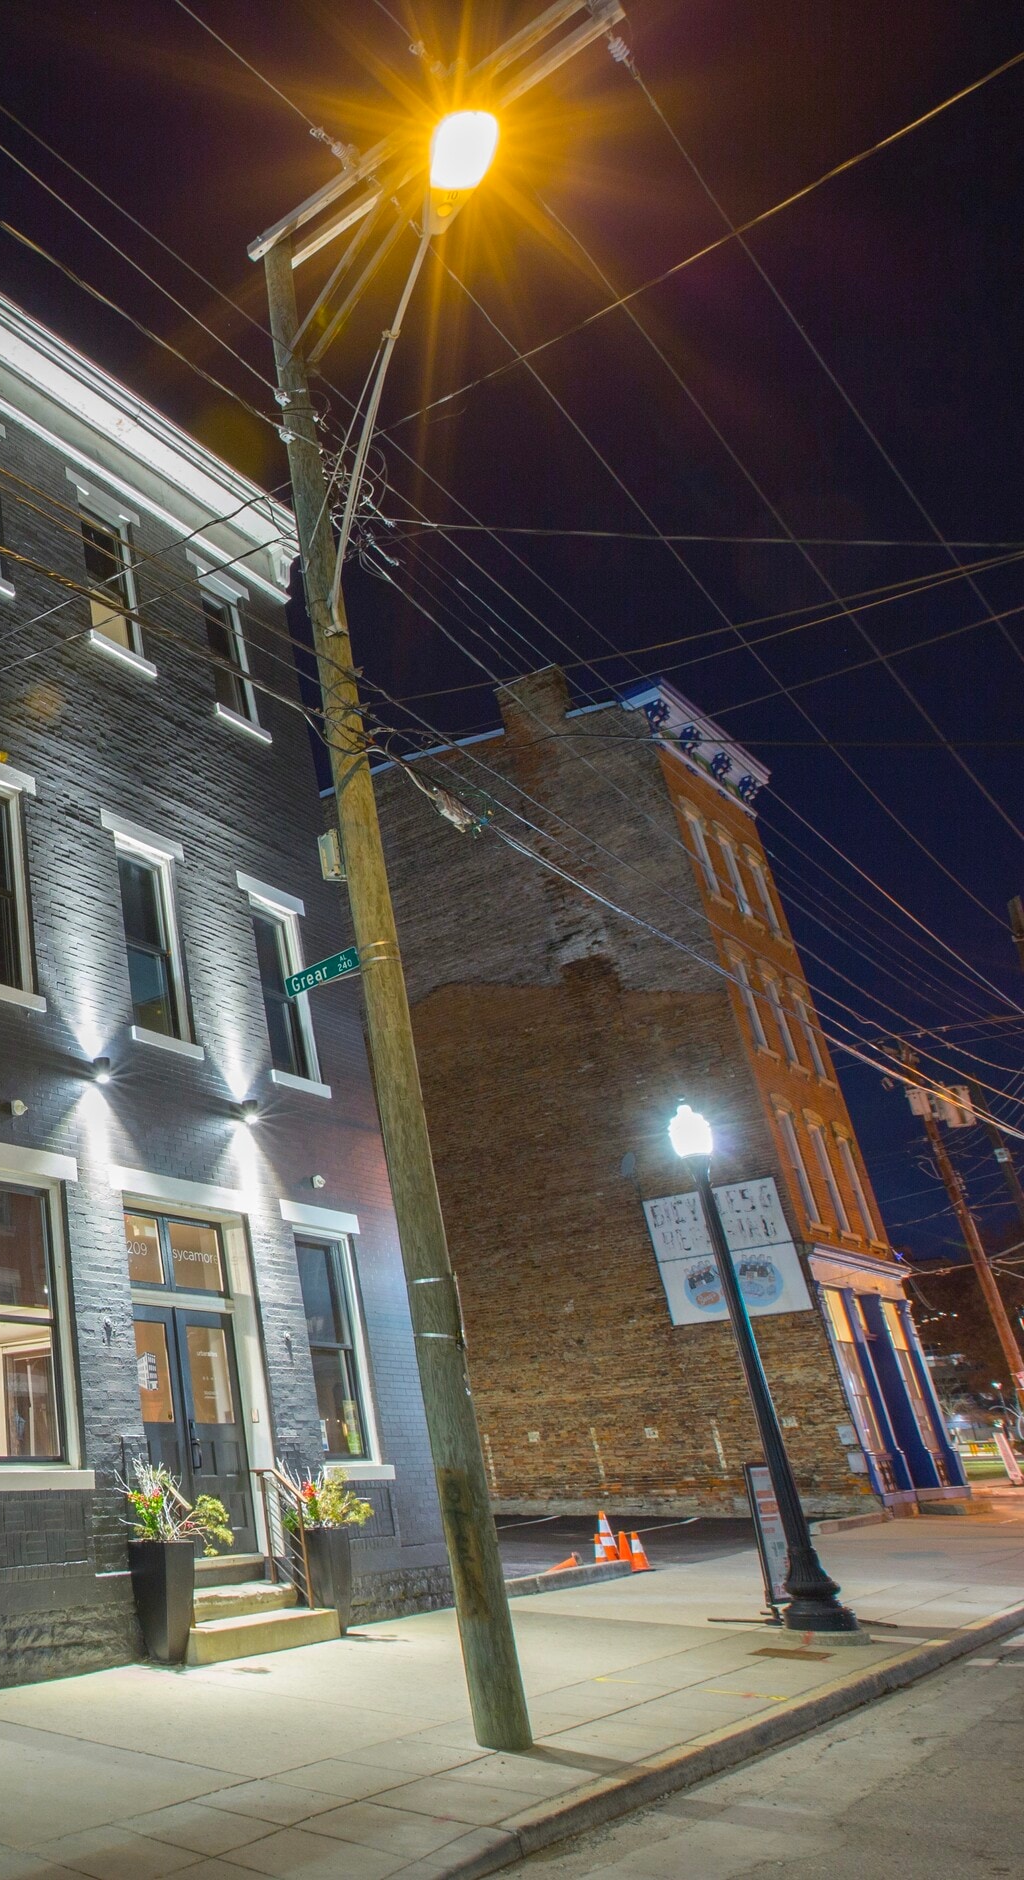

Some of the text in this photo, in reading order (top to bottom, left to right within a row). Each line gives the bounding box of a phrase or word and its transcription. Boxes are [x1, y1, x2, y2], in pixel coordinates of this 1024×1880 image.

[337, 959, 353, 972] 240
[339, 954, 348, 962] AL
[291, 966, 328, 992] Grear
[126, 1240, 219, 1265] 209 sycamore
